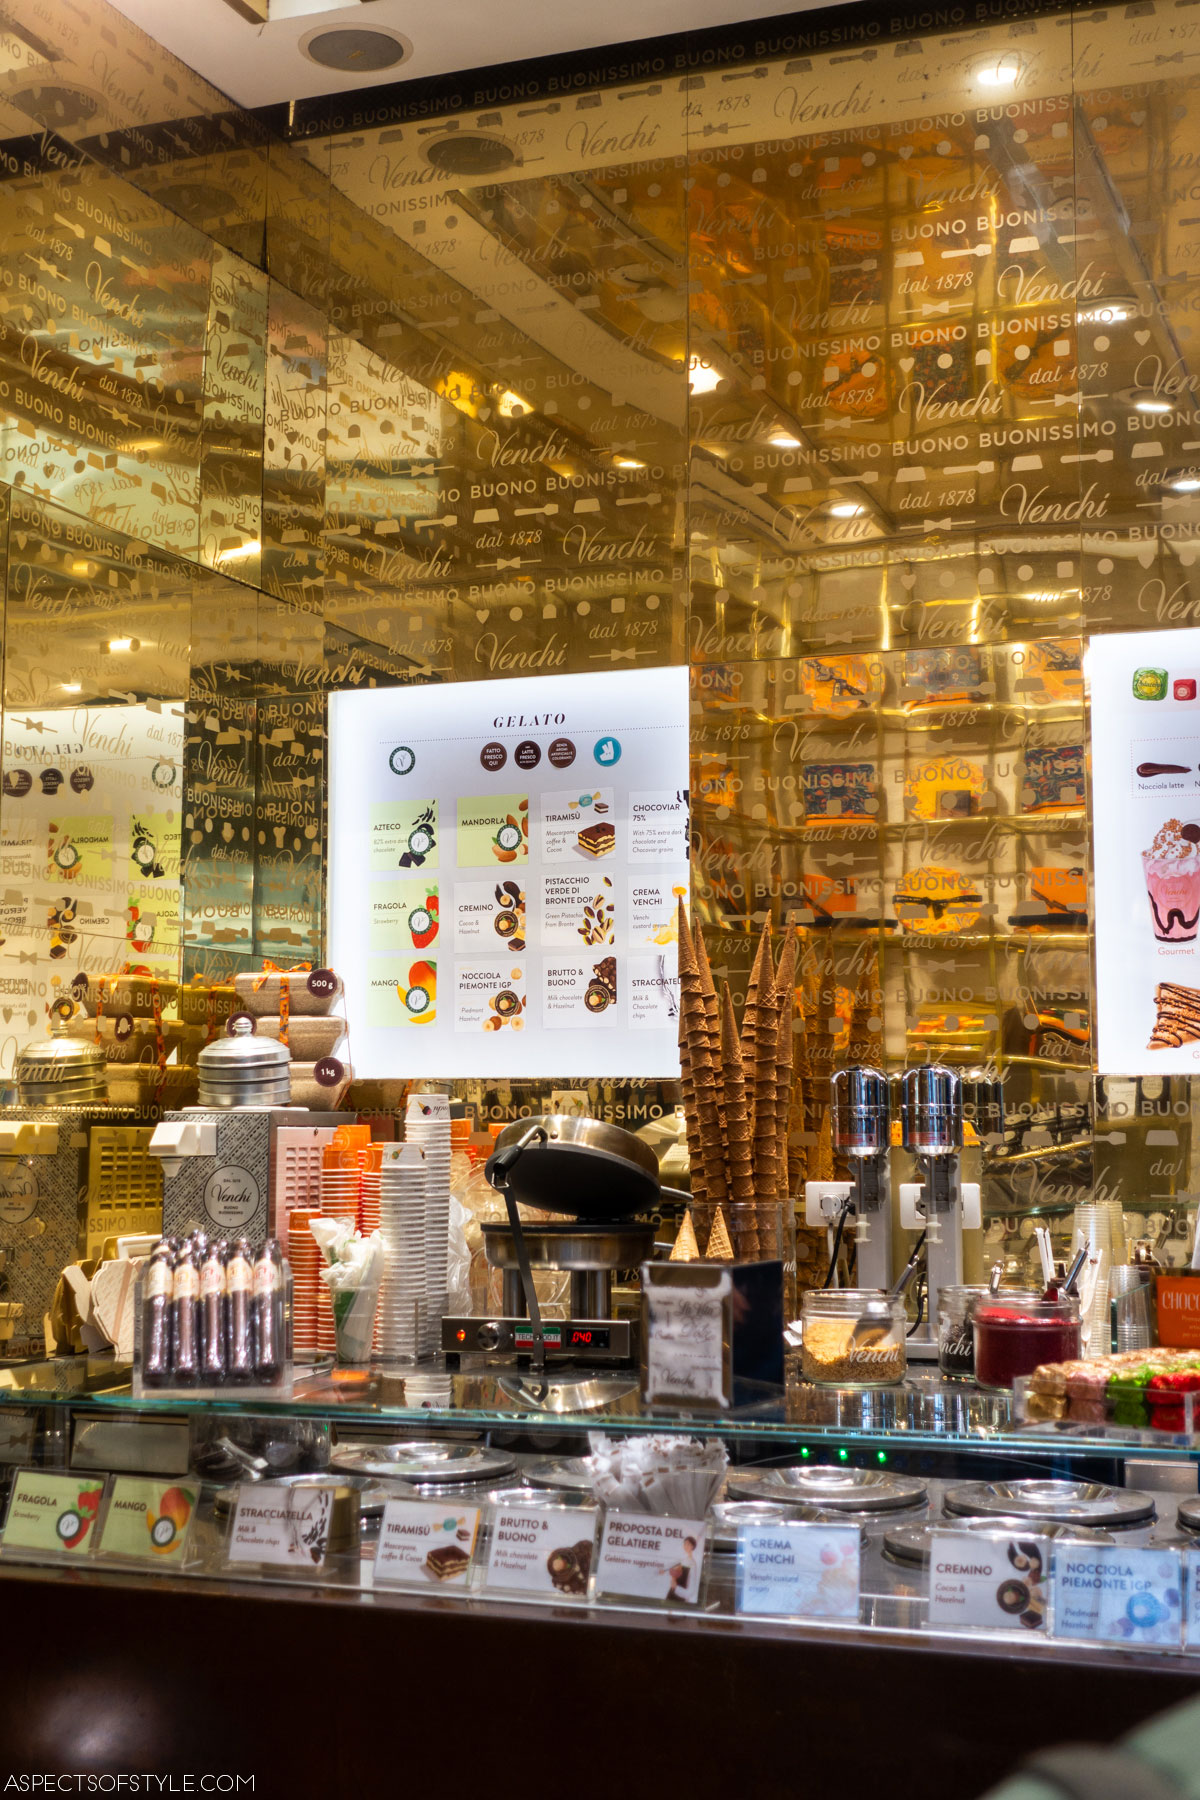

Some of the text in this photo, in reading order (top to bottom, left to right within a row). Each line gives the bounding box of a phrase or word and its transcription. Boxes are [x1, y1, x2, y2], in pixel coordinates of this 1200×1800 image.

[675, 21, 881, 69] BUONO BUONISSIMO
[773, 80, 873, 126] Venchi
[890, 86, 1112, 136] BUONO BUONISSIMO
[564, 115, 662, 160] Venchi
[77, 196, 152, 256] BUONISSIMO
[890, 219, 967, 243] BUONO
[25, 222, 74, 262] dal 1878
[898, 271, 974, 295] dal 1878
[996, 260, 1107, 306] Venchi
[18, 273, 67, 313] BUONO
[85, 260, 145, 329] Venchi
[891, 308, 1114, 348] BUONO BUONISSIMO
[20, 335, 87, 403] Venchi
[1028, 362, 1109, 385] dal 1878
[15, 388, 64, 424] BUONO
[898, 379, 1005, 423] Venchi
[892, 420, 1117, 457] BUONO BUONISSIMO
[476, 428, 569, 469] Venchi
[470, 465, 665, 499] BUONO BUONISSIMO
[899, 488, 977, 510] dal 1878
[1000, 482, 1111, 526] Venchi
[475, 529, 543, 550] dal 1878
[563, 523, 660, 564] Venchi
[589, 620, 659, 640] dal 1878
[474, 632, 569, 671] Venchi
[493, 713, 566, 728] GELATO
[72, 703, 135, 757] Venchi
[772, 721, 877, 763] Venchi
[895, 765, 972, 784] BUONO
[1138, 783, 1168, 791] Nocciola
[632, 803, 680, 812] CHOCOVIAR
[461, 817, 505, 826] MANDORLA
[545, 810, 580, 822] TIRAMISÙ
[632, 814, 646, 822] 75%
[373, 823, 401, 831] AZTECO
[803, 824, 878, 843] dal 1878
[546, 837, 561, 845] coffee
[658, 846, 673, 854] grains
[545, 876, 590, 886] PISTACCHIO
[545, 887, 570, 895] VERDE
[632, 888, 661, 896] CREMA
[373, 902, 407, 910] FRAGOLA
[458, 904, 494, 912] CREMINO
[545, 896, 594, 905] BRONTE DOP
[632, 898, 663, 906] VENCHI
[373, 917, 399, 925] Strawberry
[1157, 946, 1195, 956] Gourmet
[462, 972, 501, 981] NOCCIOLA
[547, 969, 577, 977] BRUTTO
[311, 980, 334, 990] 500 g
[371, 979, 399, 987] MANGO
[459, 981, 512, 990] PIEMONTE IGP
[547, 979, 576, 987] BUONO
[326, 1067, 336, 1077] kg
[465, 1104, 664, 1120] BUONO BUONISSIMO
[988, 1101, 1129, 1119] BUONISSIMO
[1010, 1159, 1124, 1202] Venchi
[211, 1183, 252, 1202] Venchi
[839, 1335, 900, 1365] Venchi
[16, 1493, 58, 1507] FRAGOLA
[114, 1499, 147, 1512] MANGO
[239, 1507, 313, 1521] STRACCIATELLA
[386, 1523, 431, 1537] TIRAMISÙ
[499, 1516, 549, 1531] BRUTTO &
[608, 1521, 686, 1540] PROPOSTA DEL
[497, 1530, 536, 1543] BUONO
[607, 1536, 662, 1551] GELATIERE
[750, 1538, 792, 1550] CREMA
[750, 1553, 796, 1566] VENCHI
[936, 1562, 993, 1577] CREMINO
[1066, 1562, 1133, 1577] NOCCIOLA
[1061, 1576, 1153, 1592] PIEMONTE IGP
